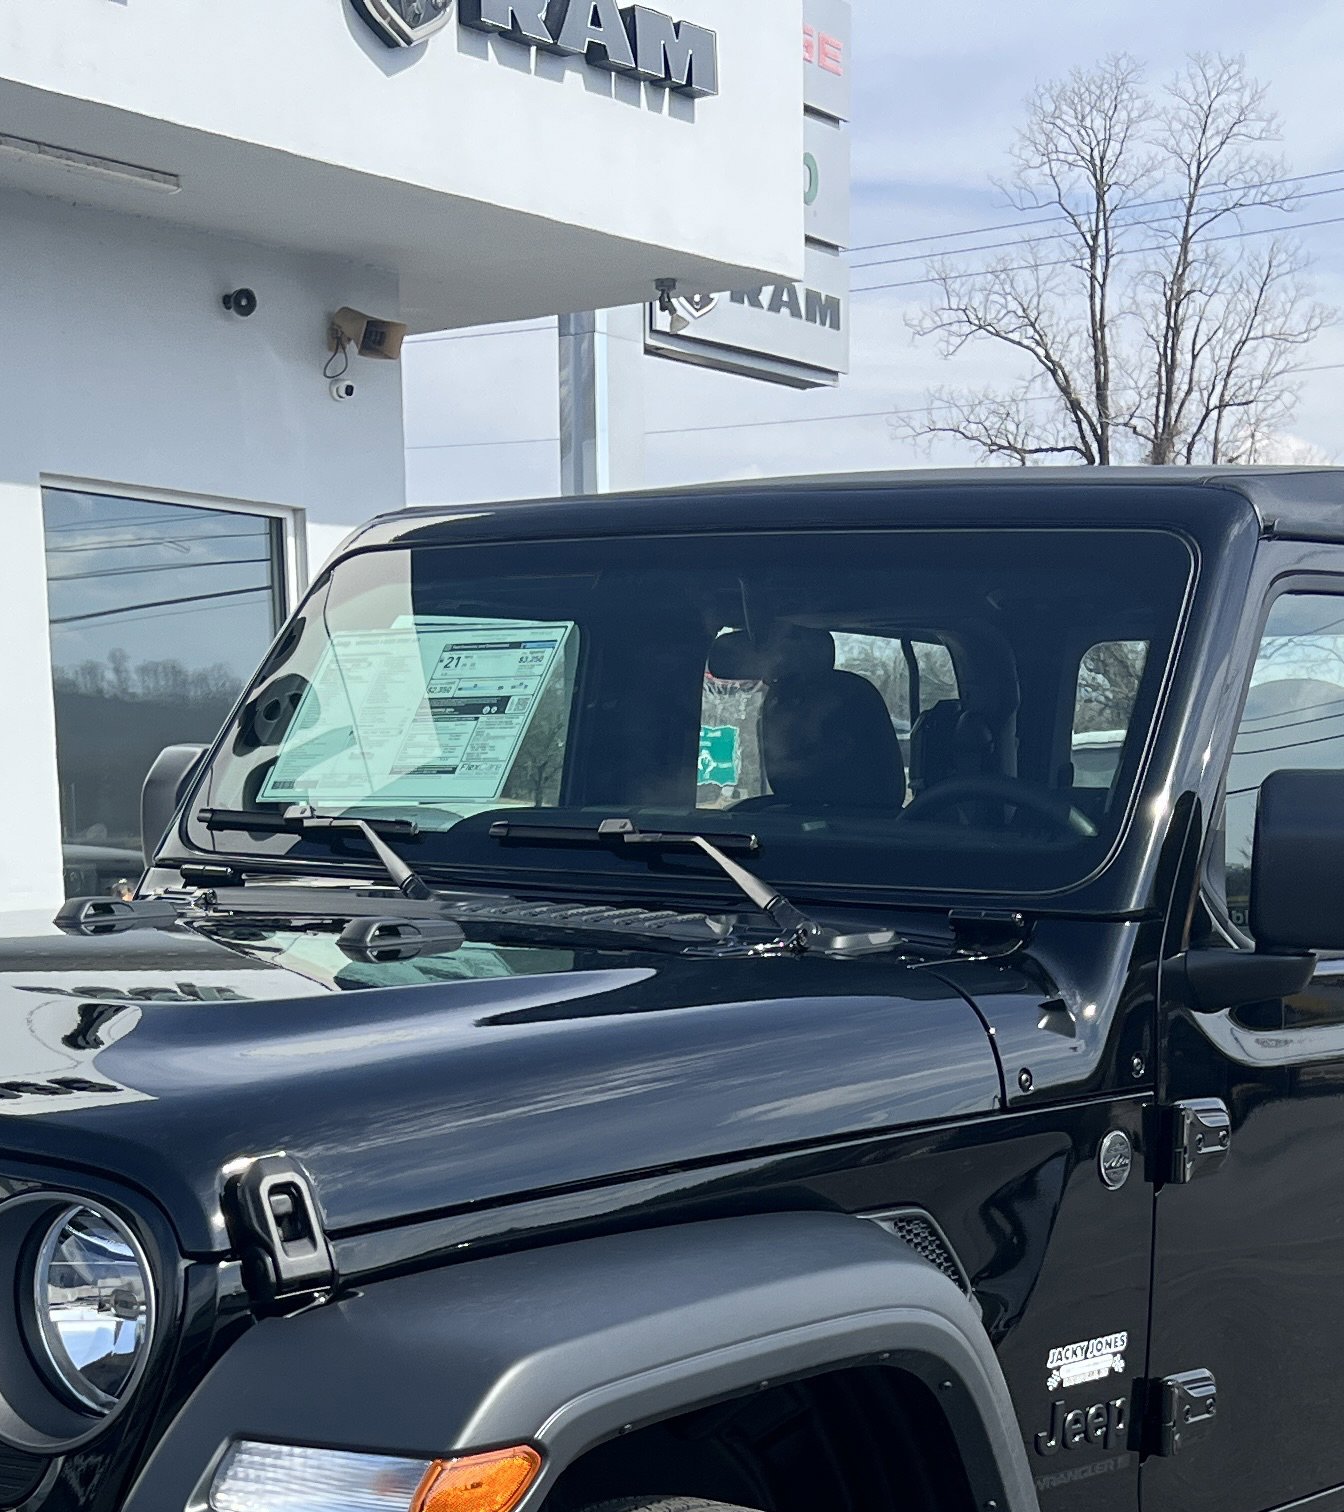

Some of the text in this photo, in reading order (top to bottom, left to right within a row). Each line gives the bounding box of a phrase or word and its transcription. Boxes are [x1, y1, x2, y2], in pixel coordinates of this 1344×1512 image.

[459, 0, 719, 97] RAM
[1049, 1333, 1126, 1365] JACKY JONES
[1034, 1397, 1126, 1457] Jeep
